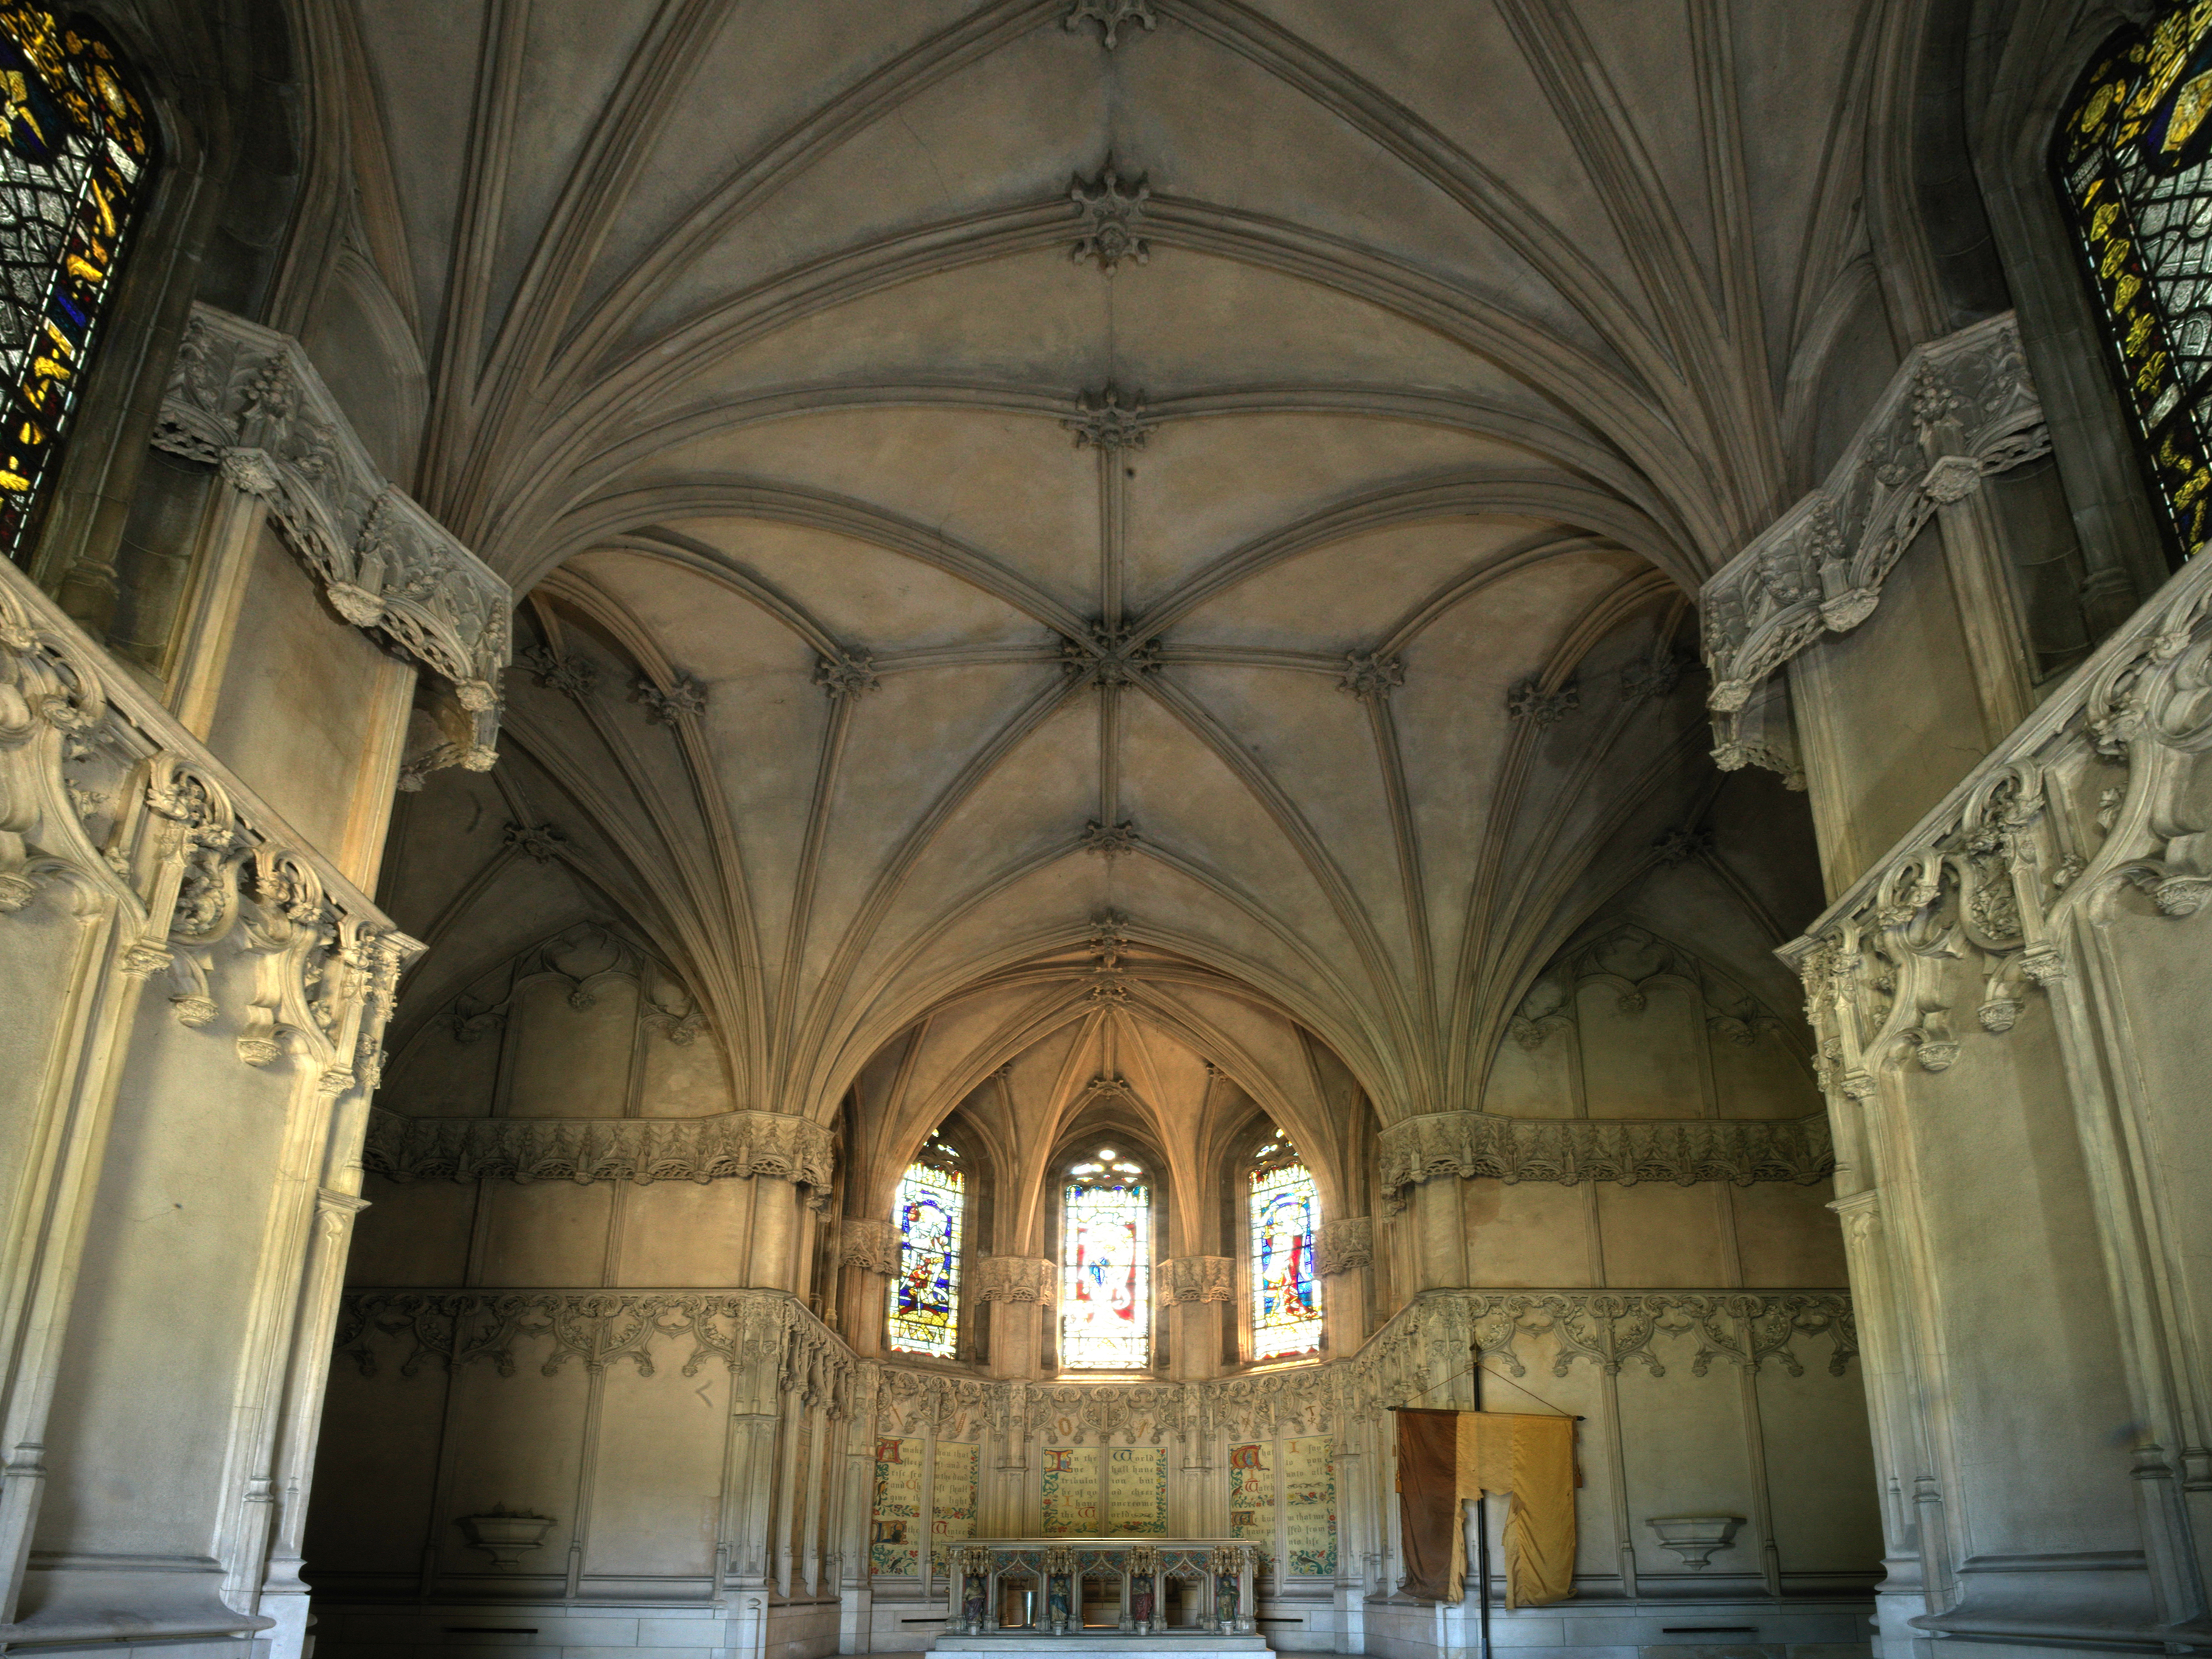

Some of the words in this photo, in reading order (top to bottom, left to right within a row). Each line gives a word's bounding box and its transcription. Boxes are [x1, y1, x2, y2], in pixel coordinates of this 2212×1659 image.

[937, 1448, 950, 1456] hou
[1289, 1441, 1300, 1454] I
[1084, 1454, 1097, 1462] the
[1112, 1449, 1154, 1464] World
[1307, 1458, 1322, 1467] you
[1111, 1466, 1130, 1475] hall
[1132, 1466, 1154, 1475] have
[1247, 1468, 1257, 1481] I
[1312, 1467, 1324, 1475] all
[941, 1472, 951, 1482] the
[953, 1473, 968, 1481] dead
[891, 1481, 905, 1489] and
[1244, 1479, 1275, 1494] Watch
[1075, 1489, 1084, 1498] of
[1111, 1488, 1122, 1496] od
[1131, 1488, 1154, 1496] cheer
[890, 1495, 907, 1503] give
[949, 1496, 967, 1506] light
[1062, 1495, 1074, 1507] I
[1075, 1499, 1097, 1507] have
[1061, 1510, 1075, 1519] the
[1296, 1512, 1311, 1523] that
[908, 1526, 919, 1536] the
[931, 1520, 966, 1538] Winter
[1246, 1527, 1265, 1536] have
[1306, 1524, 1325, 1534] from
[1306, 1537, 1319, 1547] life
